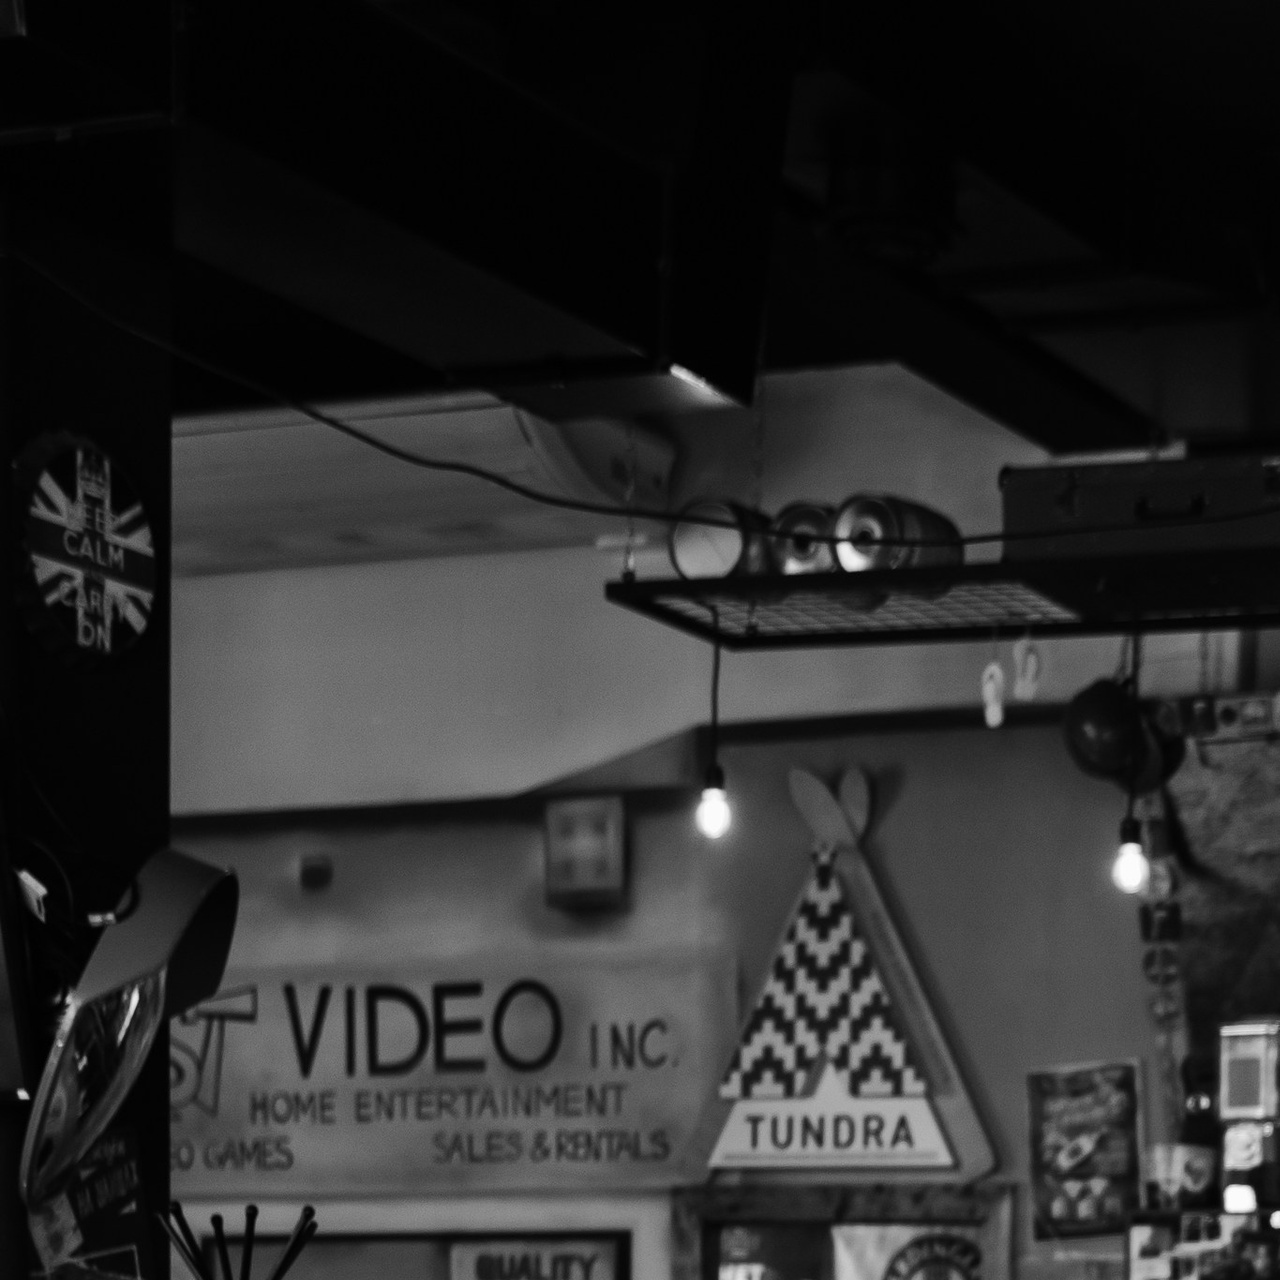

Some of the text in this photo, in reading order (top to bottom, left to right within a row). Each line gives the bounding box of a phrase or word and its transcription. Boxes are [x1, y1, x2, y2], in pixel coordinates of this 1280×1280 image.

[64, 530, 125, 573] CALM
[283, 978, 563, 1079] VIDEO
[249, 1082, 627, 1125] HOME ENTERTAINMENT
[431, 1130, 522, 1163] SALES
[746, 1113, 915, 1151] TUNDRA
[203, 1134, 294, 1172] GAMES
